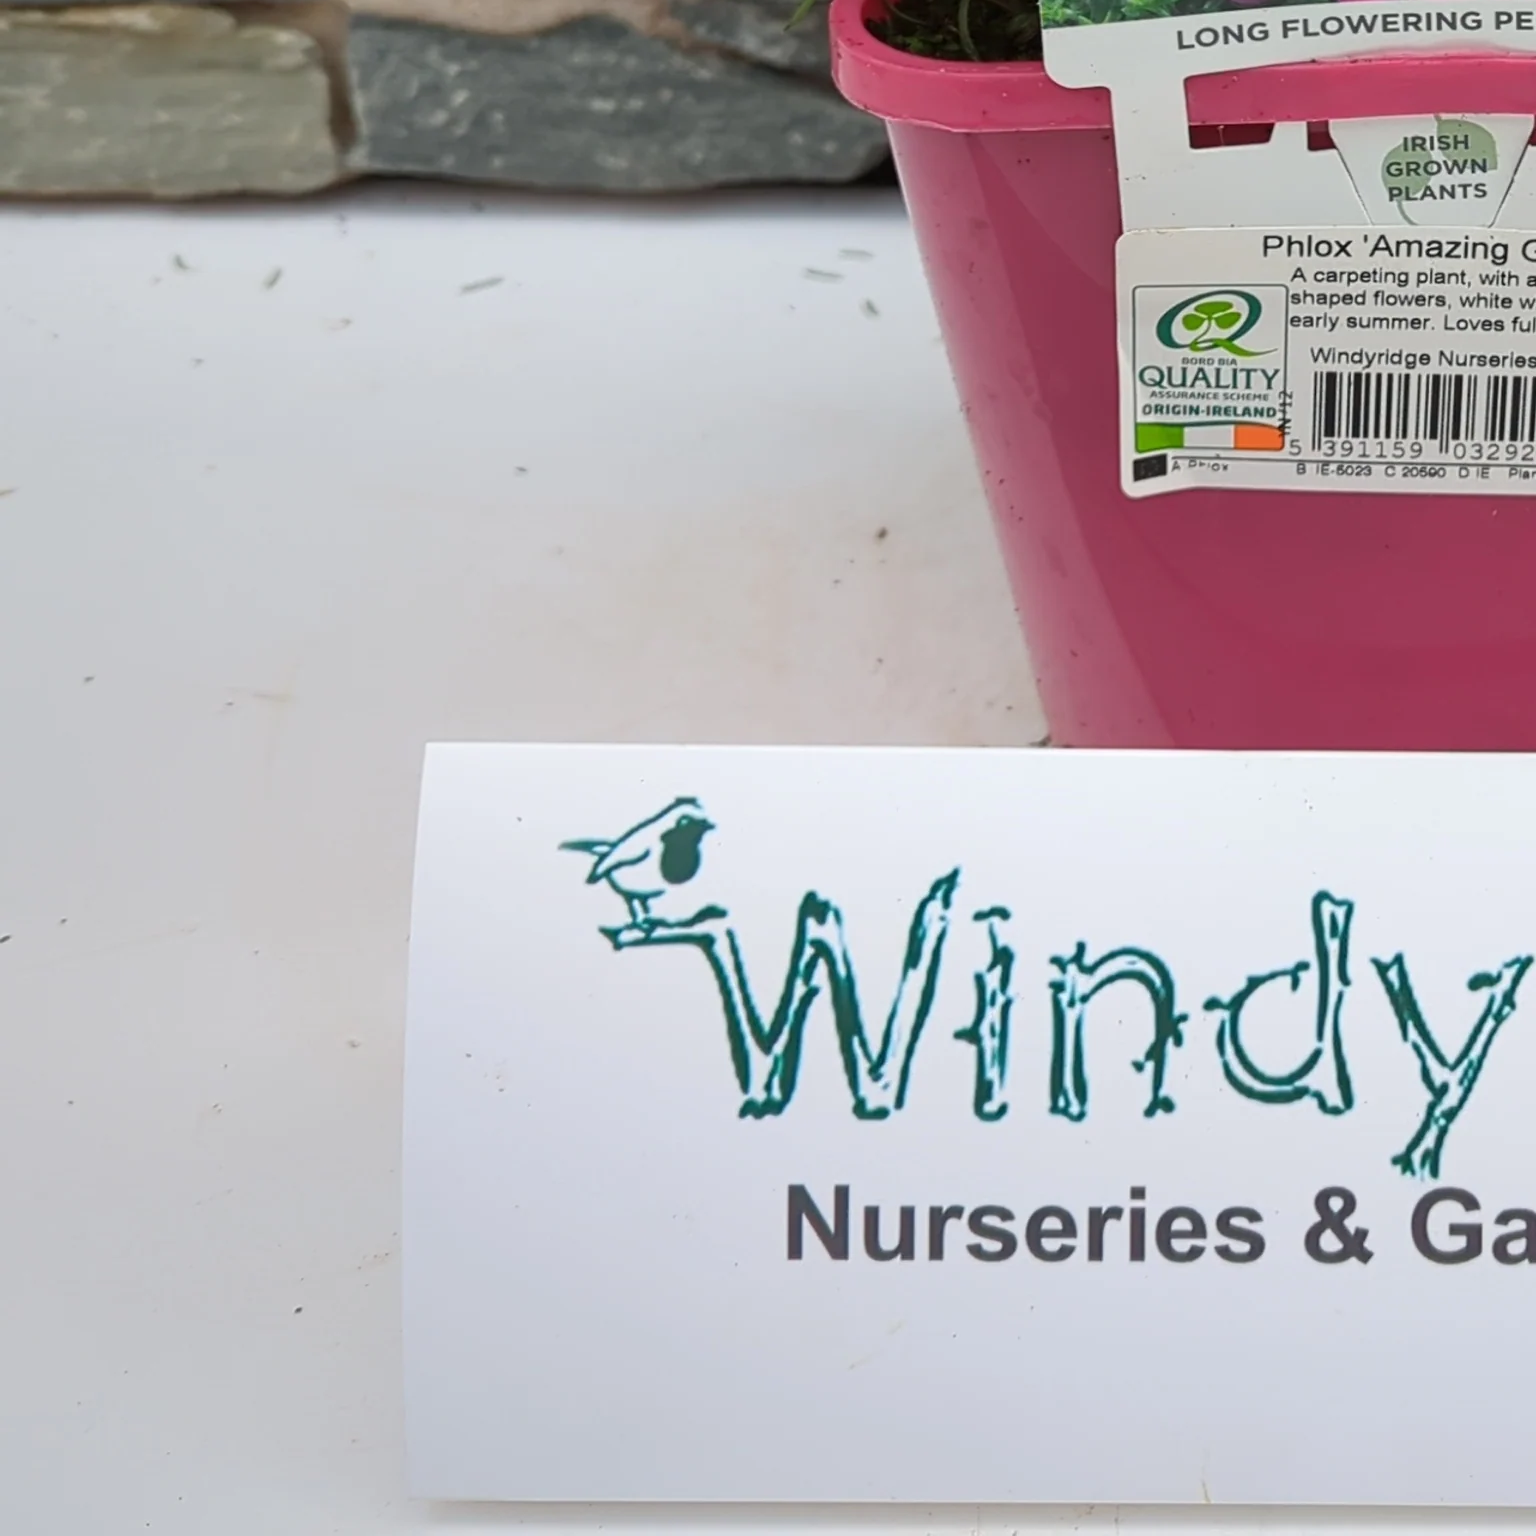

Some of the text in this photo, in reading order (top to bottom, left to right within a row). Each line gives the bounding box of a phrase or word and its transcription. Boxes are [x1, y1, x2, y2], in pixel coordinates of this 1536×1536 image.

[1177, 21, 1270, 50] LONG
[1281, 11, 1483, 39] FLOWERING
[1402, 133, 1471, 153] IRISH
[1385, 158, 1488, 178] GROWN
[1387, 182, 1488, 202] PLANTS
[1262, 234, 1353, 258] Phlox
[1363, 234, 1509, 265] 'Amazing
[1290, 267, 1307, 283] A
[1313, 268, 1409, 287] carpeting
[1416, 268, 1472, 288] plant,
[1479, 271, 1520, 287] with
[1290, 290, 1366, 311] shaped
[1373, 291, 1451, 309] flowers,
[1459, 293, 1513, 310] white
[1289, 313, 1340, 332] early
[1346, 316, 1436, 331] summer.
[1444, 314, 1505, 332] Loves
[1310, 347, 1431, 370] Windyridge
[1138, 365, 1281, 390] QUALITY
[1149, 390, 1270, 402] ASSURANCE SCHEME
[1142, 403, 1277, 418] ORIGIN-IRELAND
[1289, 439, 1302, 456] 5
[1322, 440, 1423, 459] 391159
[1296, 464, 1306, 475] B
[1385, 465, 1396, 477] C
[1458, 467, 1470, 478] D
[1476, 467, 1490, 479] IE
[786, 1184, 1266, 1264] Nurseries
[1303, 1185, 1375, 1265] &
